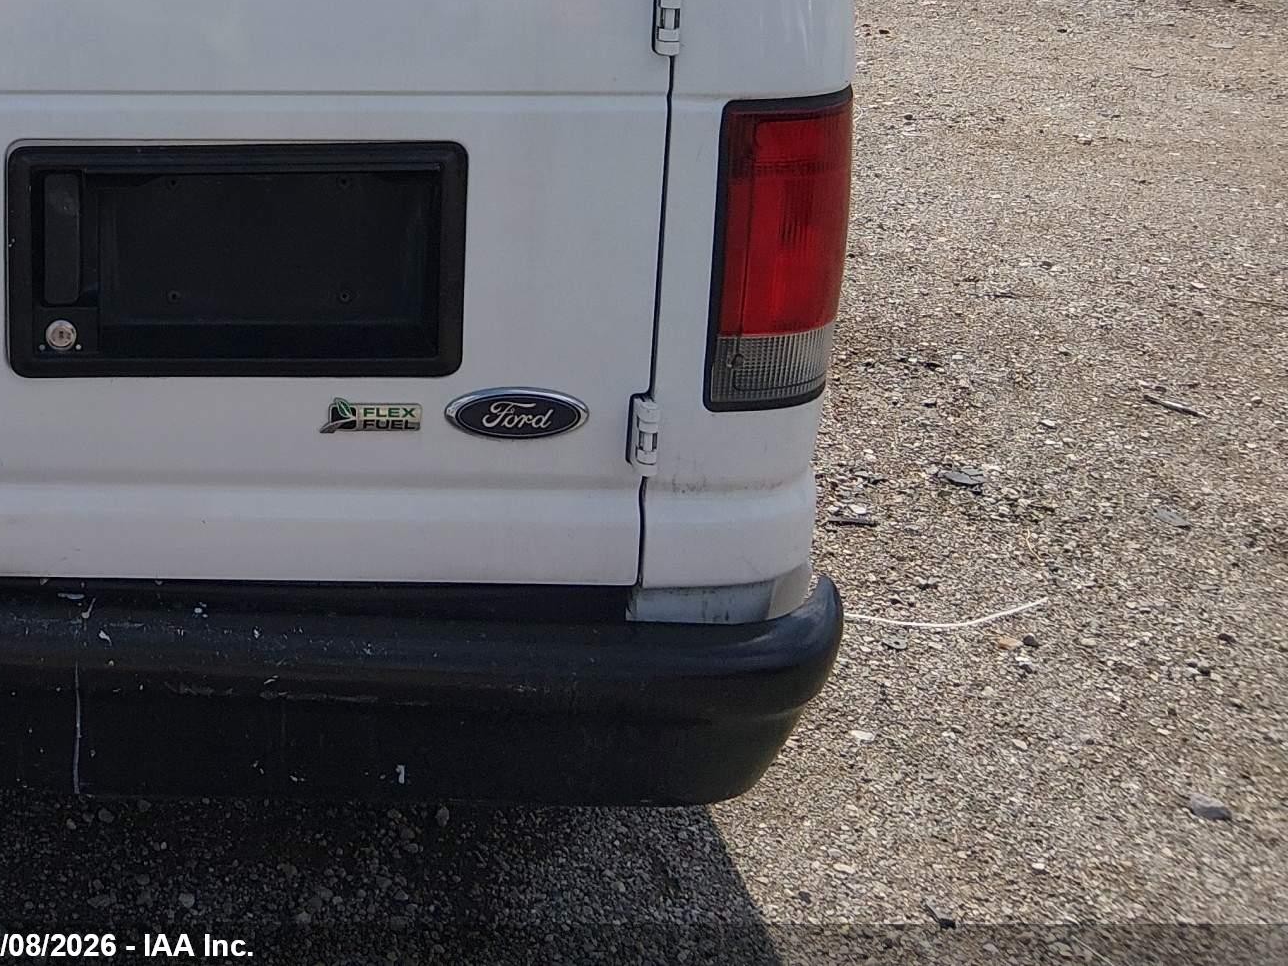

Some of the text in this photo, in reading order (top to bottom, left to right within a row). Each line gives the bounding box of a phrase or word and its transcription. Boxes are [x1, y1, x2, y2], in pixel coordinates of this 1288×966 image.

[363, 407, 416, 418] FLEX
[482, 400, 551, 429] Ford
[363, 419, 418, 430] FUEL
